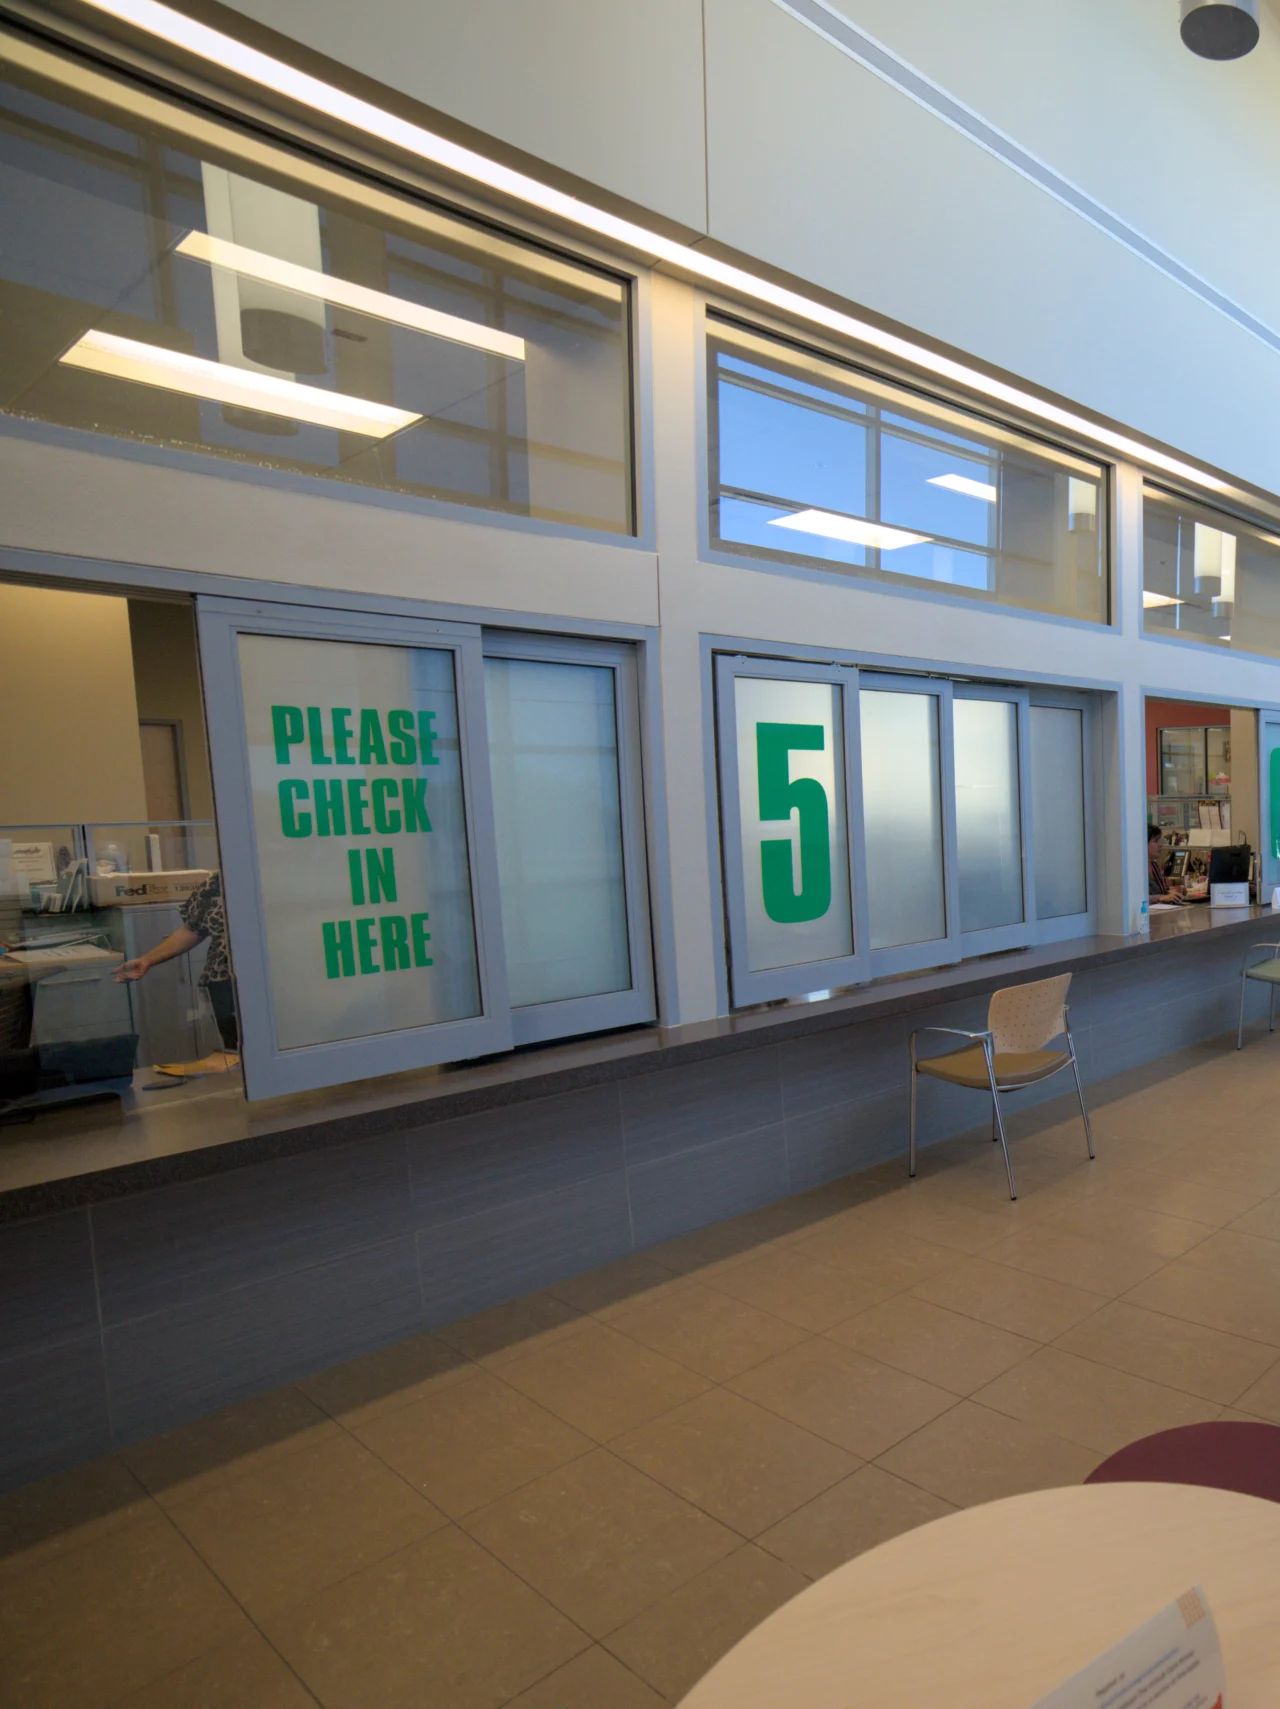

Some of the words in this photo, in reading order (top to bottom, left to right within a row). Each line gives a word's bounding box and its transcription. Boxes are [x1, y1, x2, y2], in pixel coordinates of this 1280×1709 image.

[271, 705, 440, 766] PLEASE
[278, 778, 433, 838] CHECK
[756, 722, 832, 924] 5
[347, 847, 397, 906] IN
[321, 912, 434, 979] HERE
